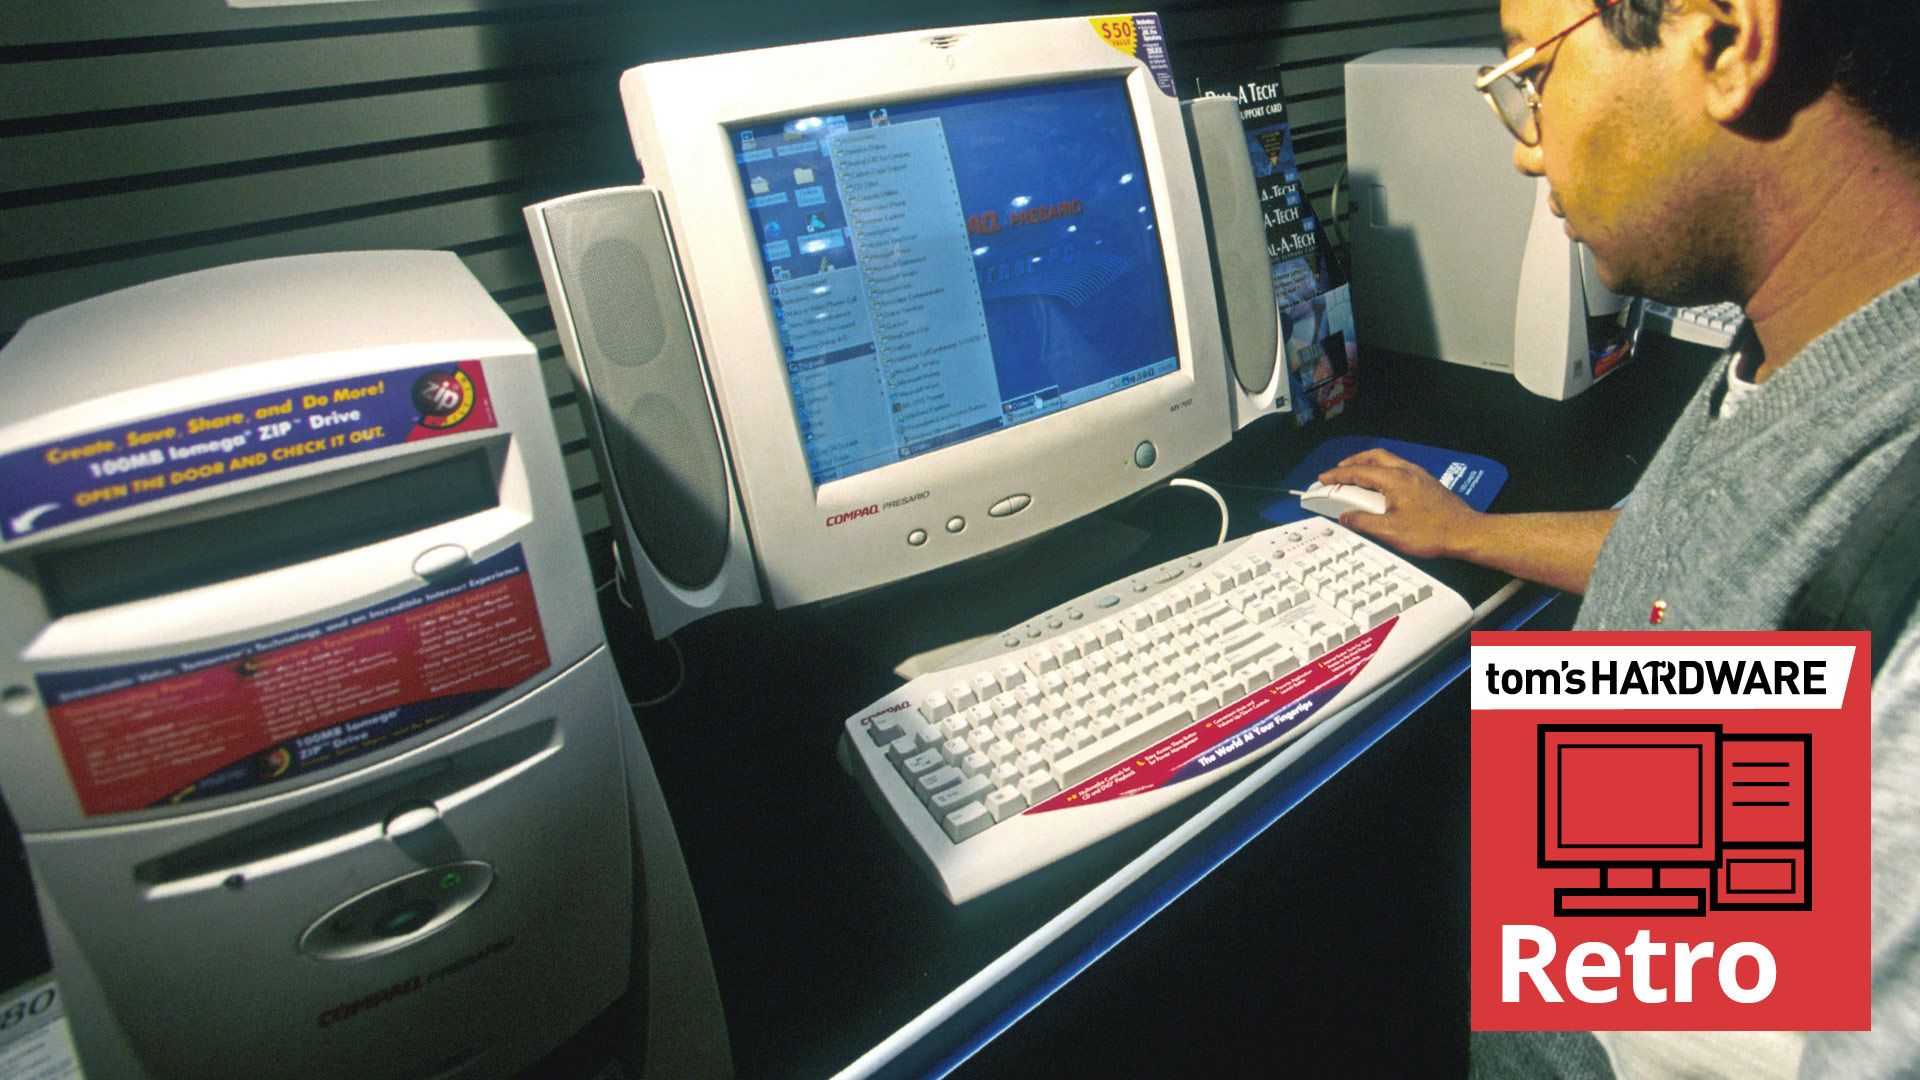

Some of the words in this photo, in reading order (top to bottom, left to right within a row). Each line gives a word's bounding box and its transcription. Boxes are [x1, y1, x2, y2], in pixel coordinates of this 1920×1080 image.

[1101, 21, 1131, 39] $50
[1240, 106, 1265, 120] UPPORT
[1265, 103, 1283, 115] CARD
[187, 412, 249, 434] Share,
[255, 399, 292, 419] and
[302, 394, 328, 410] Do
[333, 380, 385, 403] More!
[74, 483, 128, 507] OPEN
[132, 475, 165, 494] THE
[169, 461, 225, 485] DOOR
[229, 452, 267, 471] AND
[271, 438, 326, 461] CHECK
[330, 433, 346, 448] IT
[90, 449, 165, 478] 100MB
[309, 409, 361, 430] Drive
[825, 504, 879, 527] COMPAQ
[882, 490, 930, 510] PRESARIO
[468, 566, 521, 588] Experience
[1198, 754, 1216, 767] The
[1215, 737, 1244, 757] World
[1243, 732, 1255, 743] At
[1253, 722, 1275, 736] Your
[1273, 700, 1314, 725] Fingertips
[318, 974, 421, 1028] COMPAQ
